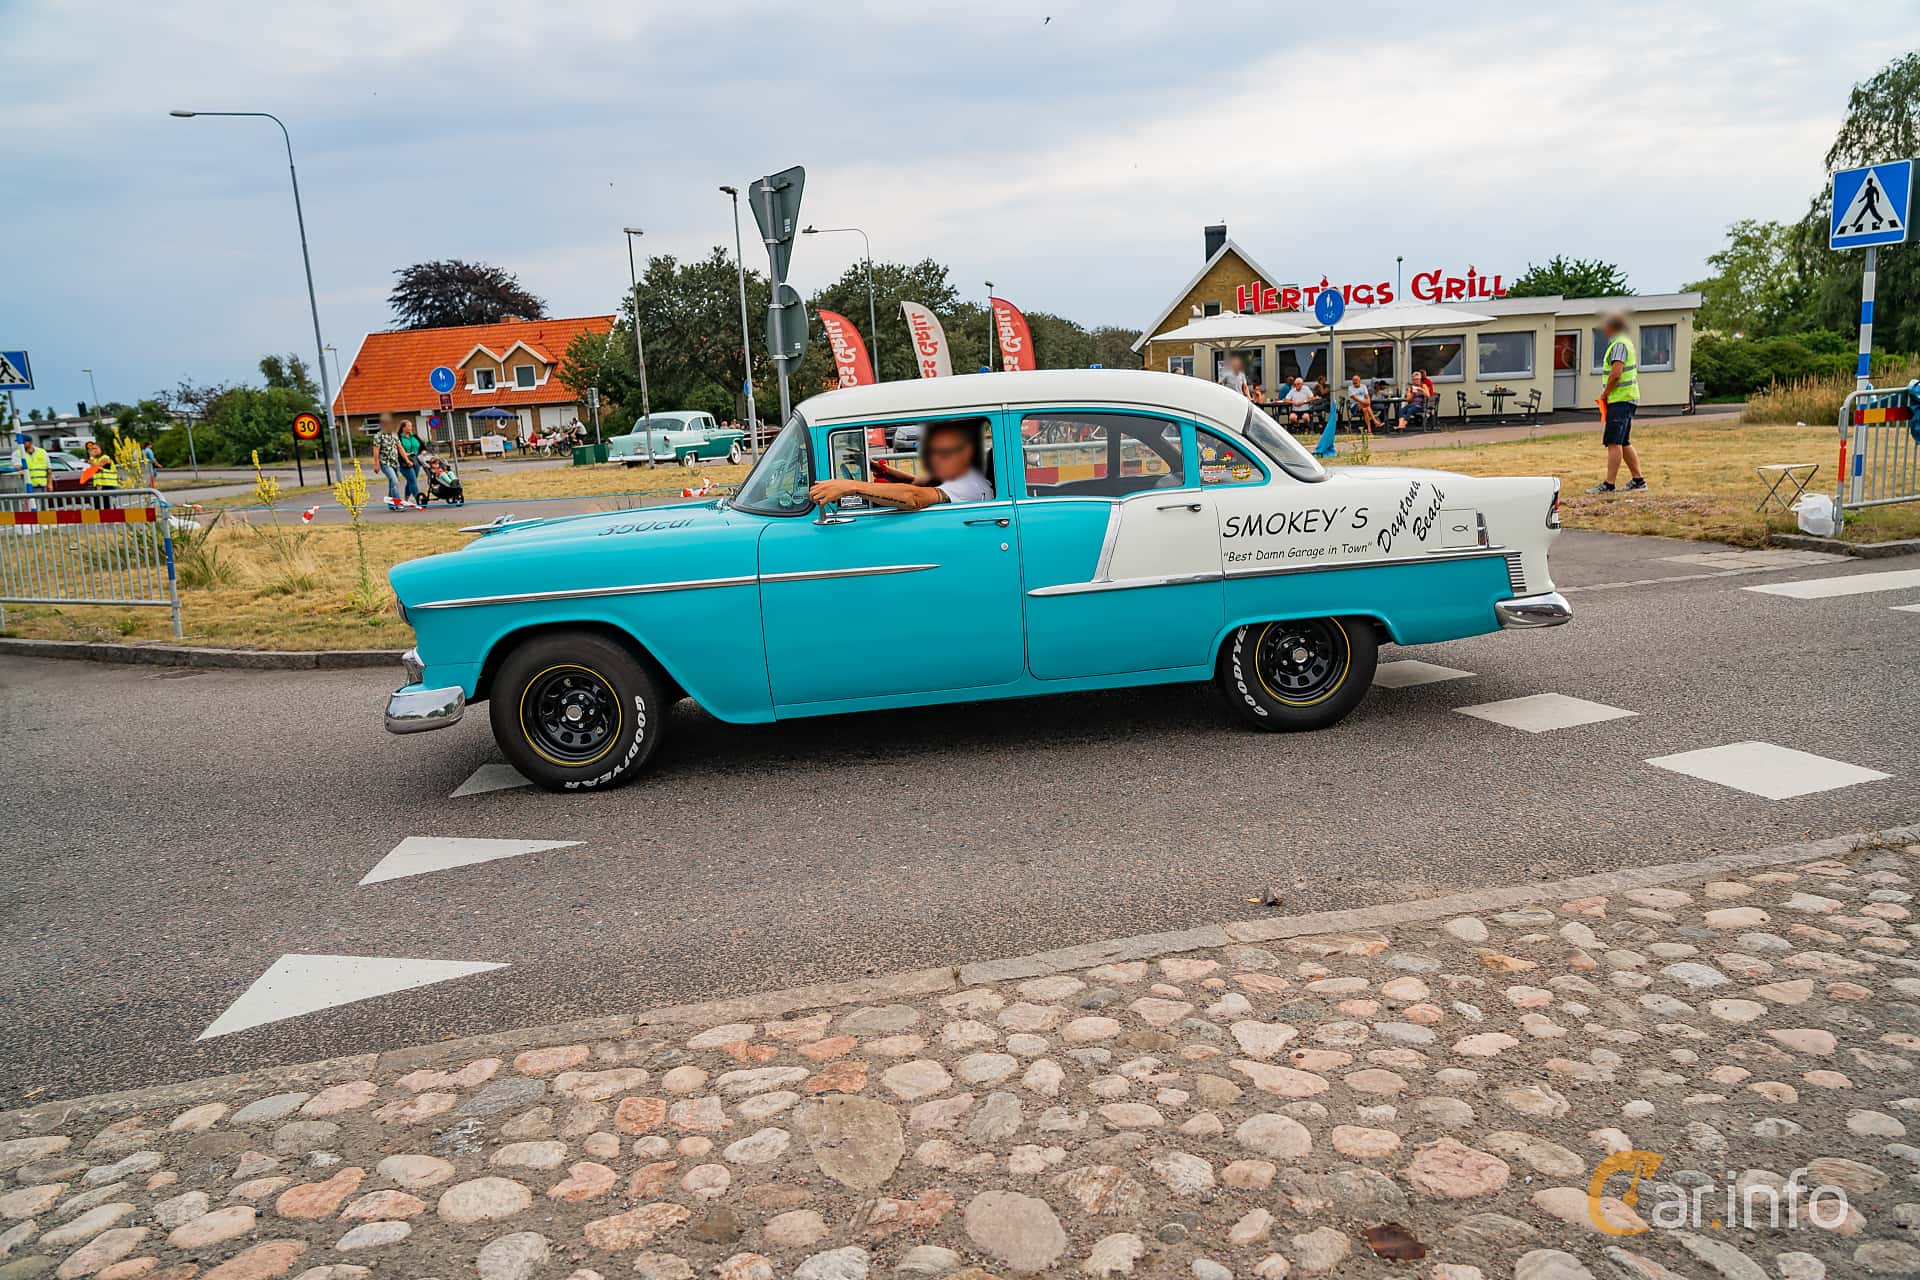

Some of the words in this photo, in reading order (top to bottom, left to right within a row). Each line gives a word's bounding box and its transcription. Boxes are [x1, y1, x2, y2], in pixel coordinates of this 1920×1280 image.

[1237, 276, 1394, 314] HERTGS
[1411, 264, 1507, 304] GRILL
[299, 420, 316, 433] 30
[1377, 480, 1421, 554] Daytona
[1412, 483, 1445, 542] Beach
[1255, 550, 1285, 560] Damn
[1287, 546, 1325, 559] Garage
[1328, 544, 1338, 555] in
[1232, 624, 1268, 717] GOODYE
[564, 695, 646, 789] GOODYEAR
